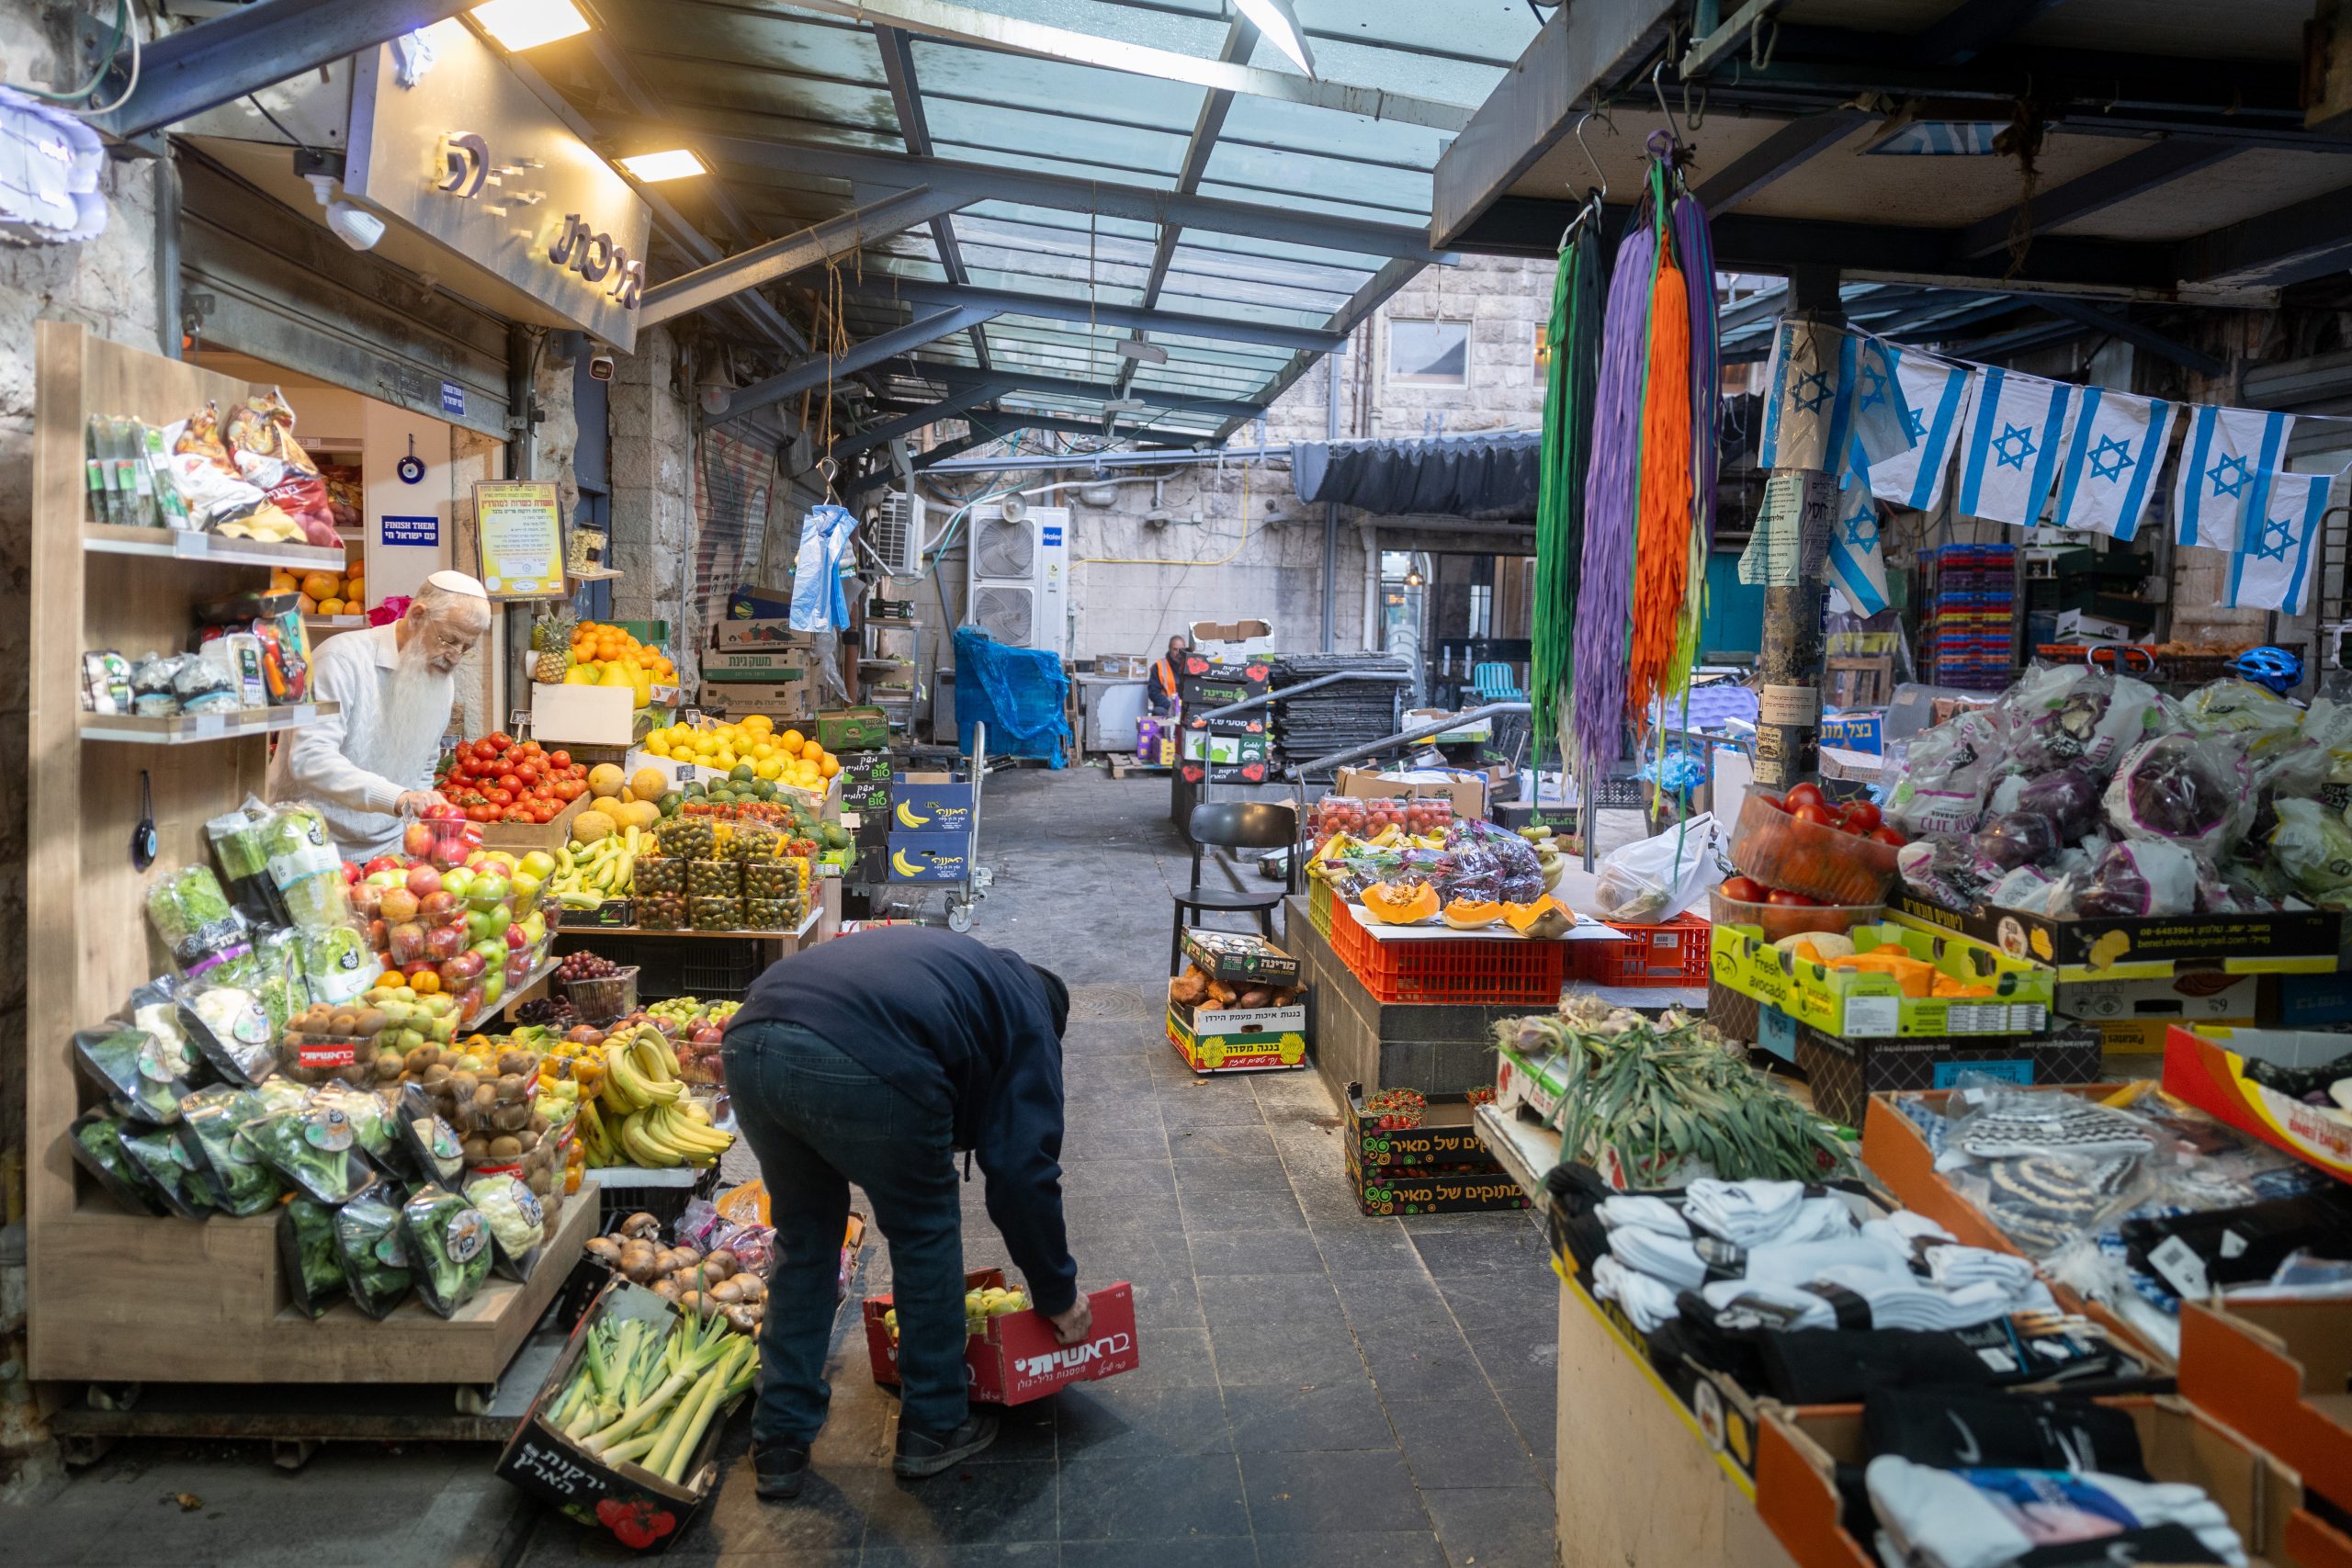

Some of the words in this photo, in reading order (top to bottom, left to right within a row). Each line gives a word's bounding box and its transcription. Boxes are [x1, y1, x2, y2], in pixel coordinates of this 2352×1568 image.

[481, 499, 508, 509] למהדרין
[384, 521, 411, 529] FINISH
[384, 531, 394, 539] חי
[395, 530, 423, 539] ישראל
[424, 532, 436, 540] עם
[1043, 533, 1062, 541] Haier
[729, 656, 748, 667] גינת
[749, 656, 772, 668] משק
[1203, 688, 1234, 699] מרינה
[1227, 719, 1249, 728] מטעי
[1847, 721, 1872, 739] בצל
[1243, 741, 1261, 750] Goldy
[860, 756, 878, 765] משק
[845, 764, 870, 773] רחמים
[871, 769, 890, 778] BIO
[856, 784, 875, 793] משק
[842, 793, 866, 801] רחמים
[868, 796, 888, 807] BIO
[935, 807, 968, 817] הבננה
[931, 856, 964, 865] הבננה
[1903, 897, 1934, 921] מובחרים
[1934, 909, 1963, 931] לימונים
[1261, 958, 1296, 971] מרינה
[1754, 953, 1781, 978] Fresh
[1748, 975, 1788, 1002] avocado
[1204, 1015, 1227, 1023] הירדן
[1229, 1013, 1252, 1022] מעמק
[1255, 1012, 1277, 1021] איכות
[1280, 1010, 1301, 1019] בננות
[2108, 1034, 2145, 1044] Patates
[1226, 1044, 1254, 1054] מסדה
[1256, 1043, 1280, 1053] בננה
[1247, 1055, 1267, 1066] טעים
[1267, 1056, 1278, 1066] נקי
[1390, 1138, 1430, 1154] מאיר
[1434, 1135, 1460, 1151] של
[1392, 1188, 1433, 1203] מאיר
[1435, 1184, 1462, 1201] של
[1028, 1332, 1130, 1377] בראשית
[1017, 1372, 1054, 1392] גליל-גולן
[513, 1452, 575, 1495] הארץ
[540, 1450, 606, 1491] ירקות
